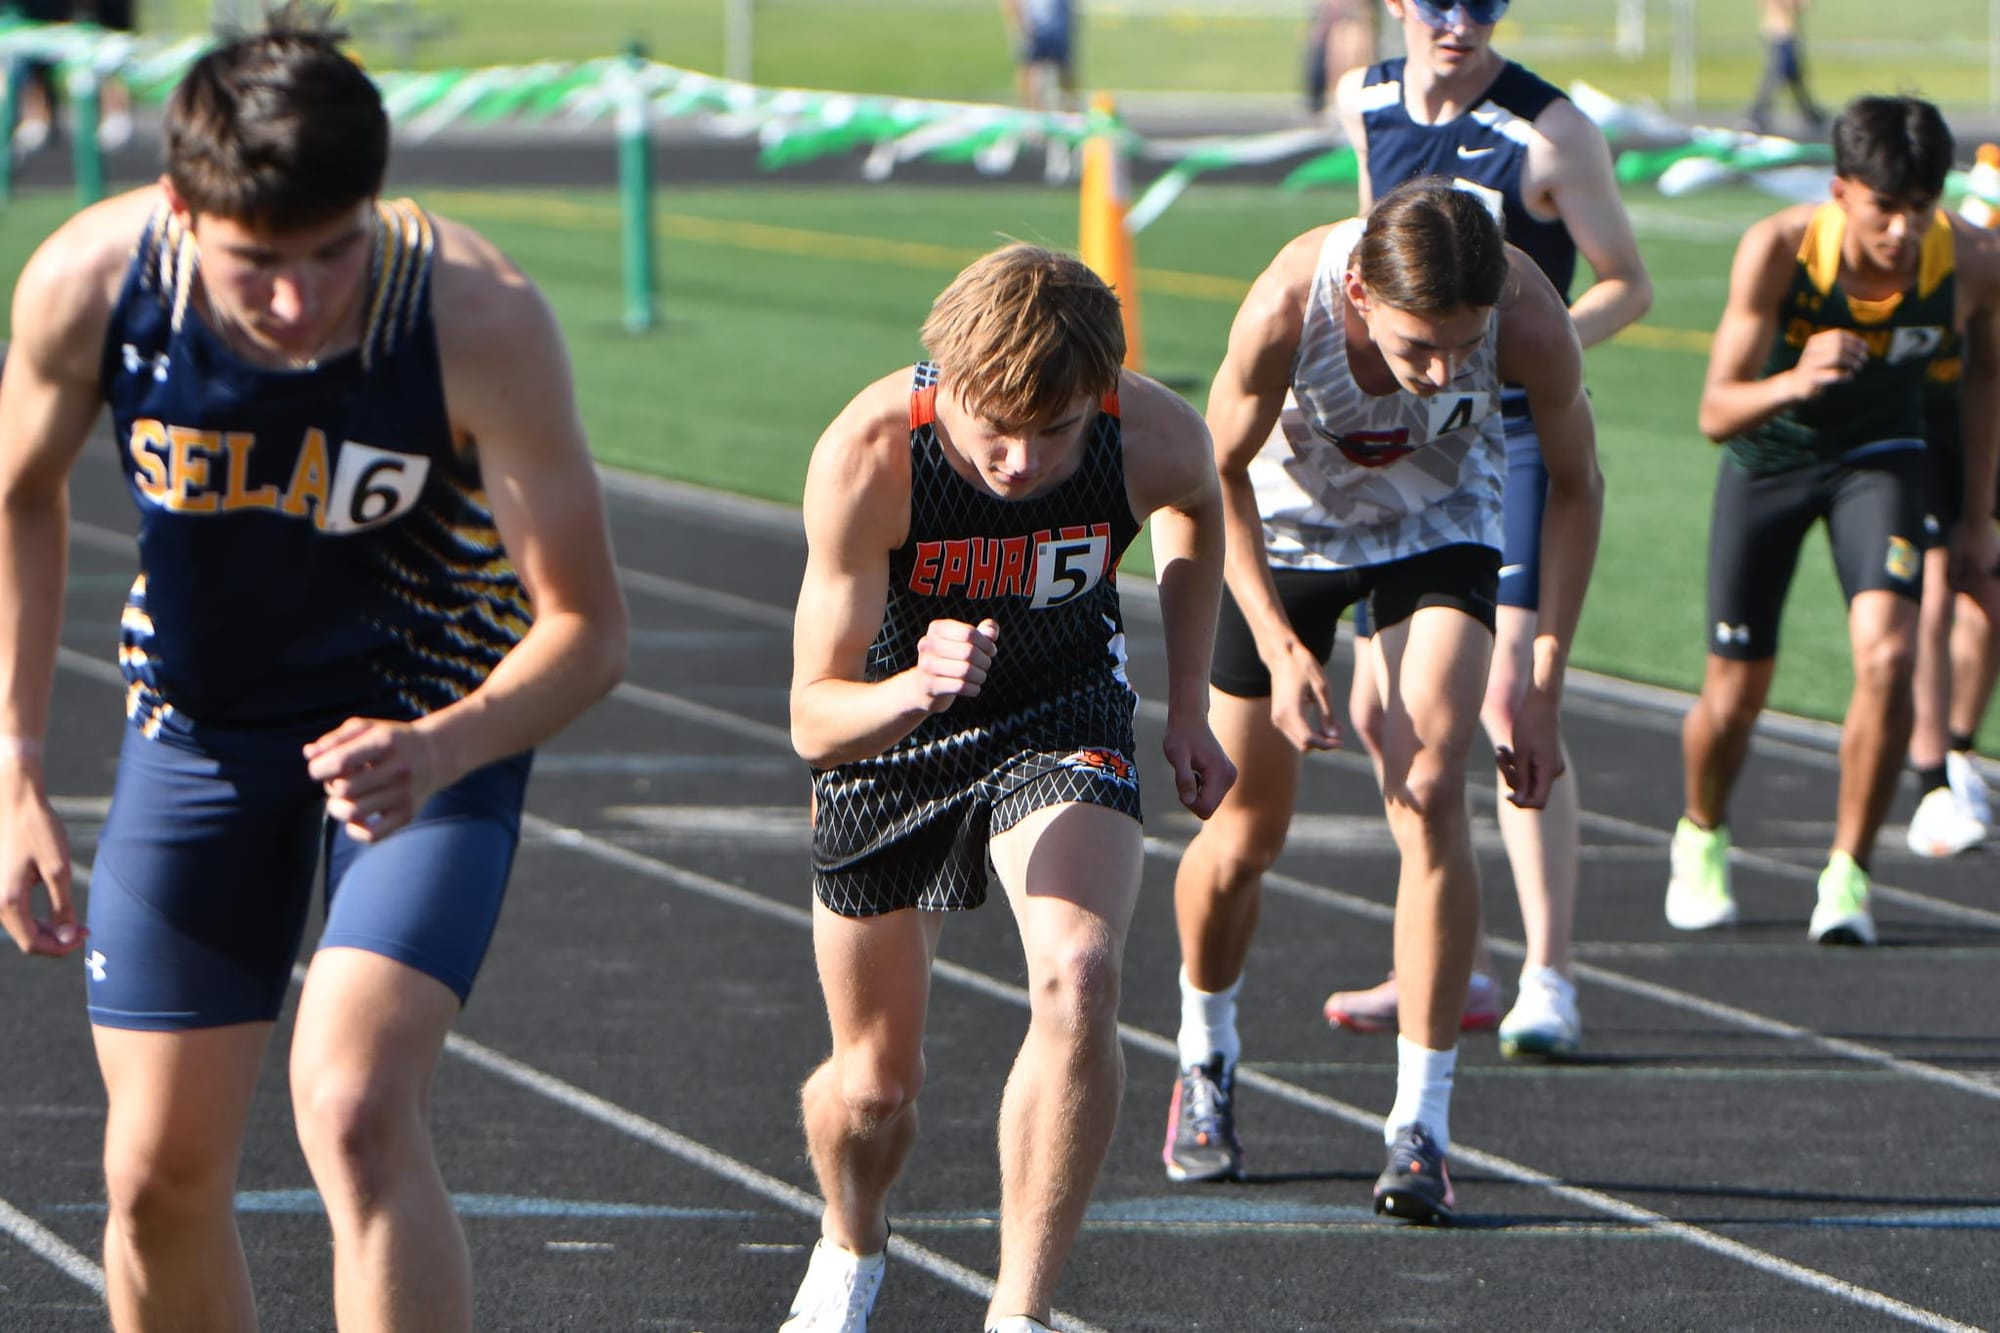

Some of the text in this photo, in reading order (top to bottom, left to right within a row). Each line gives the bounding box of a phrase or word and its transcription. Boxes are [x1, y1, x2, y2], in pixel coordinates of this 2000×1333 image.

[129, 418, 331, 530] SELA
[350, 457, 405, 525] 6
[1045, 543, 1092, 606] 5
